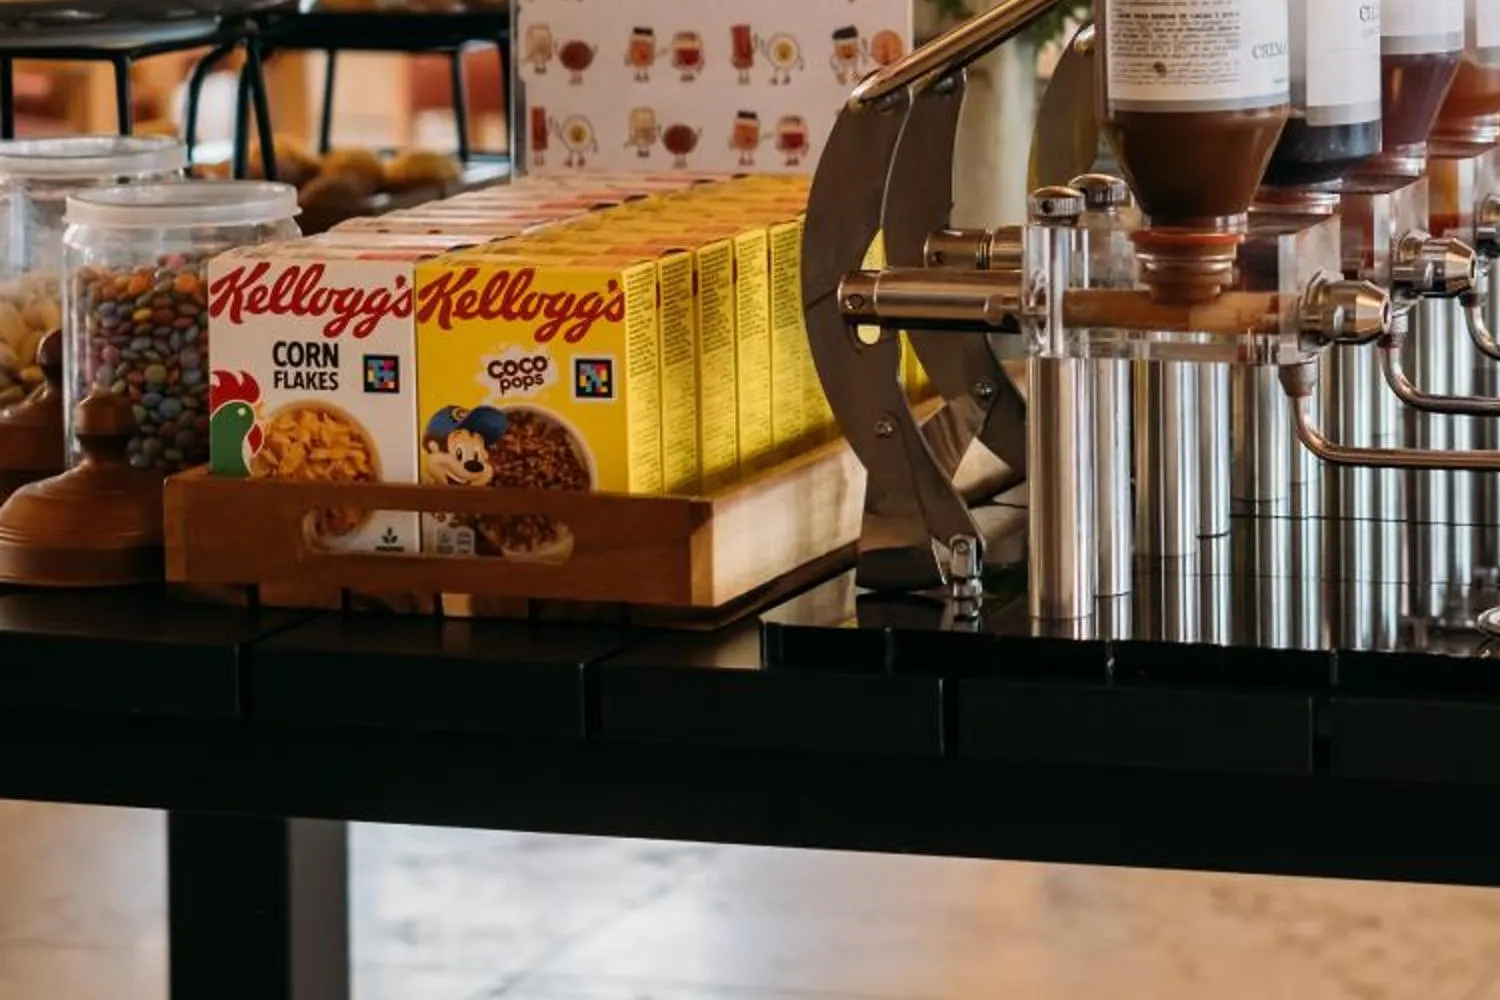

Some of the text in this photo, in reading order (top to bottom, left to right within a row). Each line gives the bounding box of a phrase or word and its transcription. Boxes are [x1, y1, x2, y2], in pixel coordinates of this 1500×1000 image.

[209, 261, 414, 339] Kellogg's
[416, 267, 626, 344] Kellogg's
[272, 341, 340, 369] CORN
[273, 370, 340, 391] FLAKES
[500, 373, 545, 395] pops
